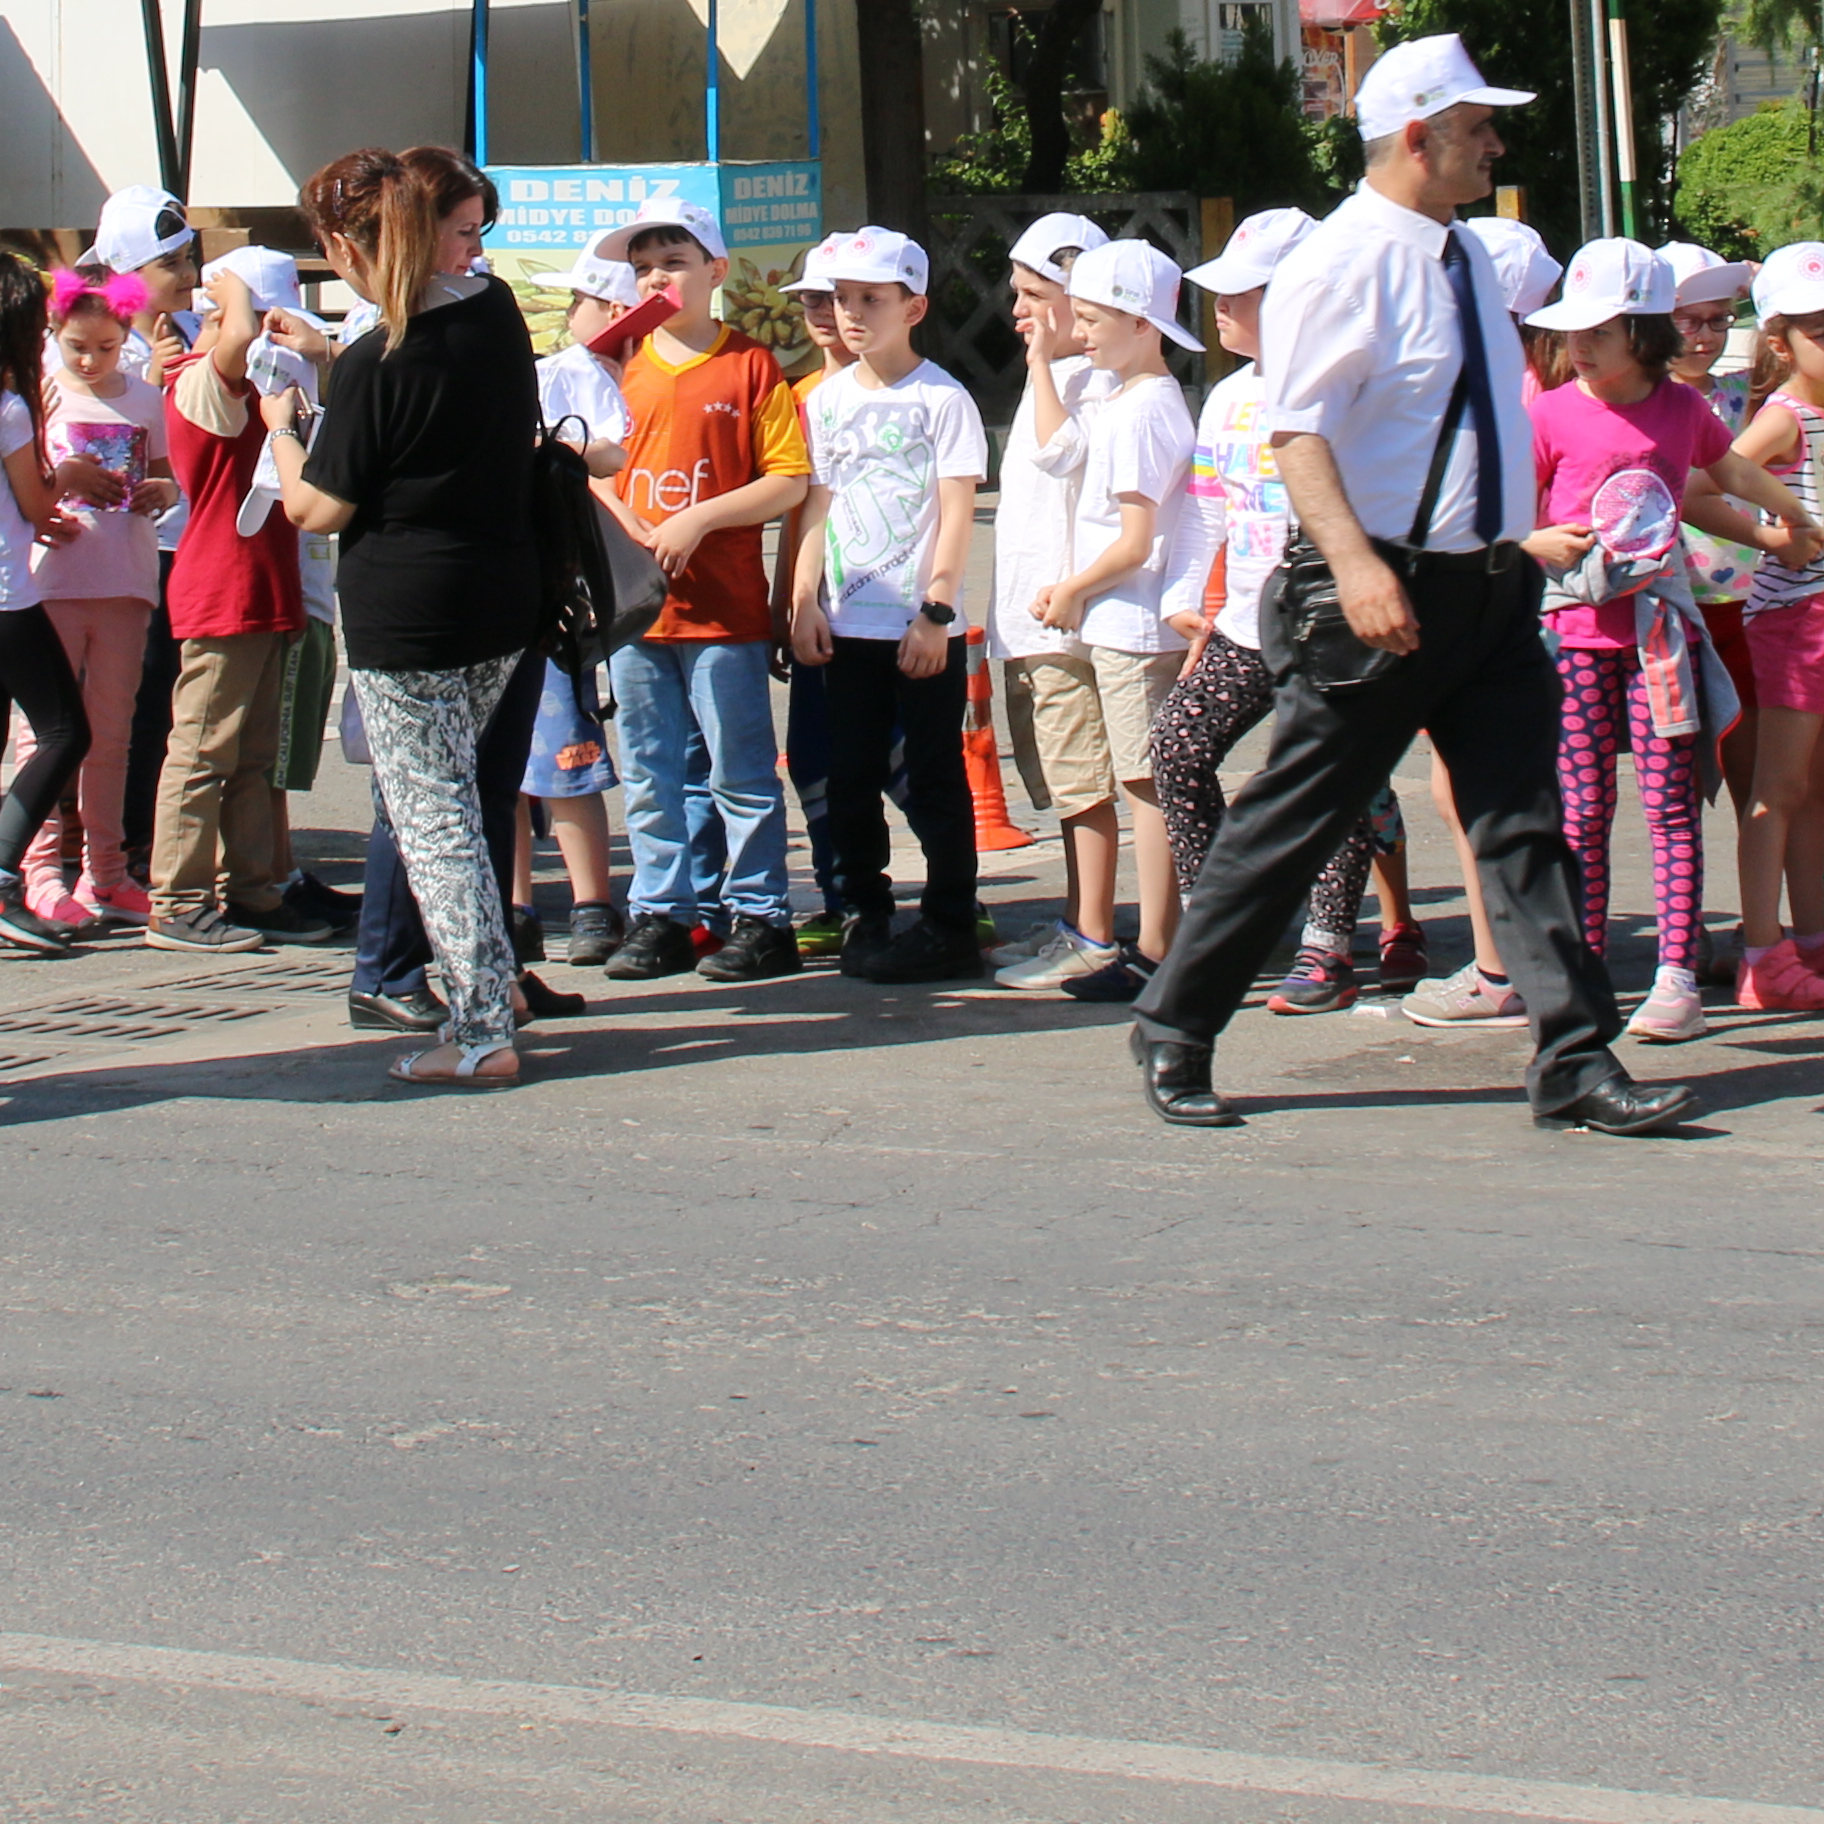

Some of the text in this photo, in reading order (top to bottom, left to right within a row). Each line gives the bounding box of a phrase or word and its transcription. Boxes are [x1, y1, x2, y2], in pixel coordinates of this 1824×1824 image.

[509, 176, 680, 202] DENİZ
[734, 171, 809, 200] DENİZ
[725, 201, 818, 224] MİDYE DOLMA
[506, 230, 567, 243] 0542
[628, 457, 710, 512] nef
